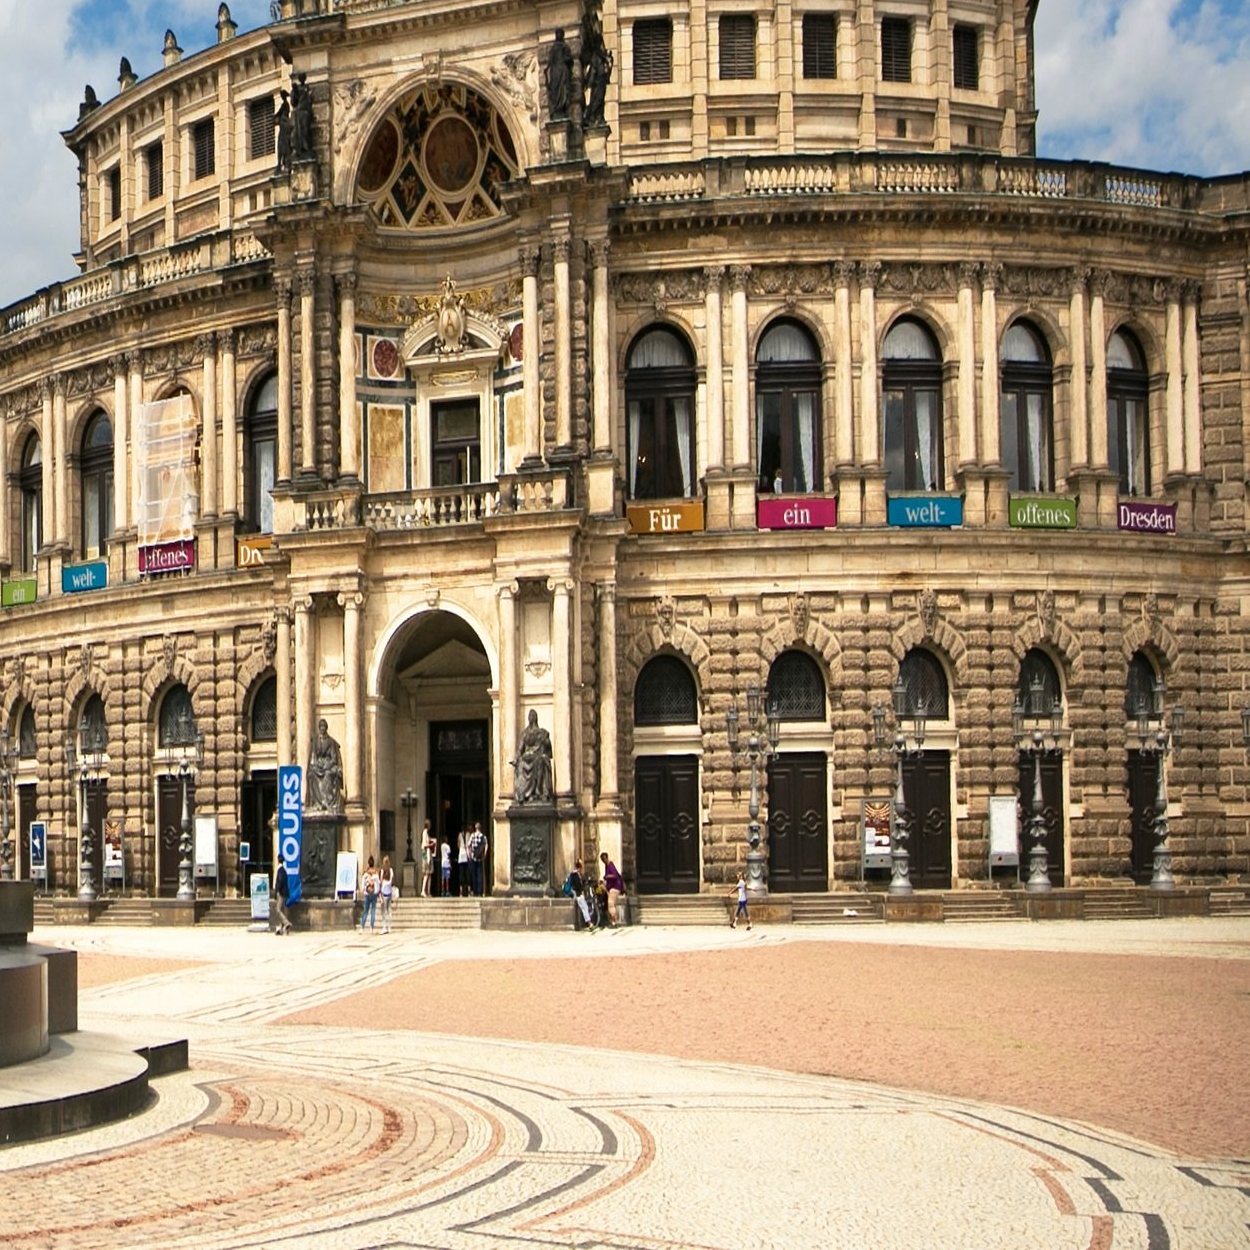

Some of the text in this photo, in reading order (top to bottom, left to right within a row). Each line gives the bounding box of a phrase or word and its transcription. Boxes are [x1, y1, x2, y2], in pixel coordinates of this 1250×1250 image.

[649, 501, 1174, 531] Für ein welt- offenes Dresden
[72, 568, 97, 588] welt-
[282, 772, 300, 876] TOURS
